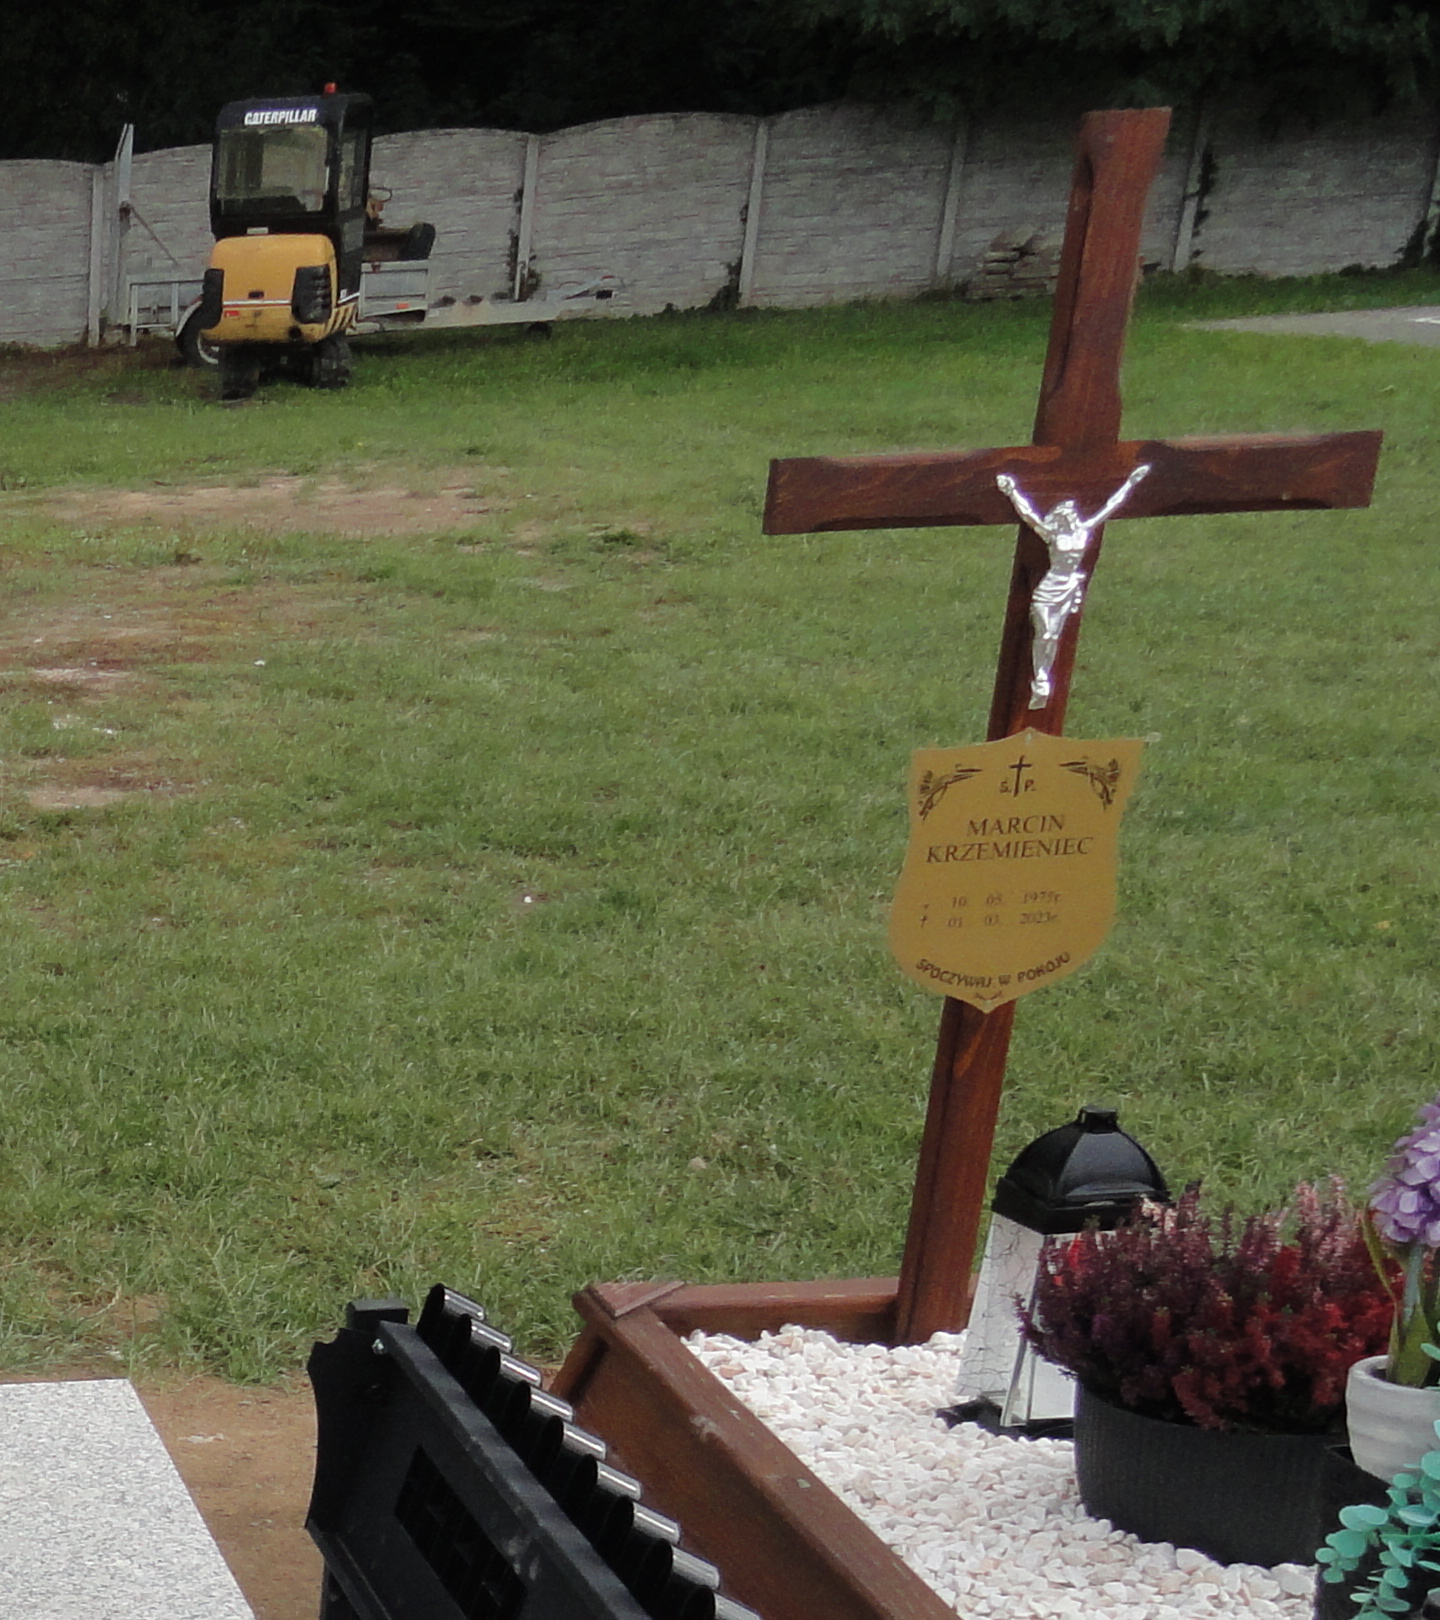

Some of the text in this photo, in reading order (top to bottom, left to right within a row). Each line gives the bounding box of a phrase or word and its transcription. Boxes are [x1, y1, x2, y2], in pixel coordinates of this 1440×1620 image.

[244, 108, 318, 126] CATERPILLAR
[967, 814, 1066, 837] MARCIN
[925, 836, 1094, 864] KRZEMIENIEC
[915, 951, 1071, 988] SPOCZYWAJ W POKOJU
